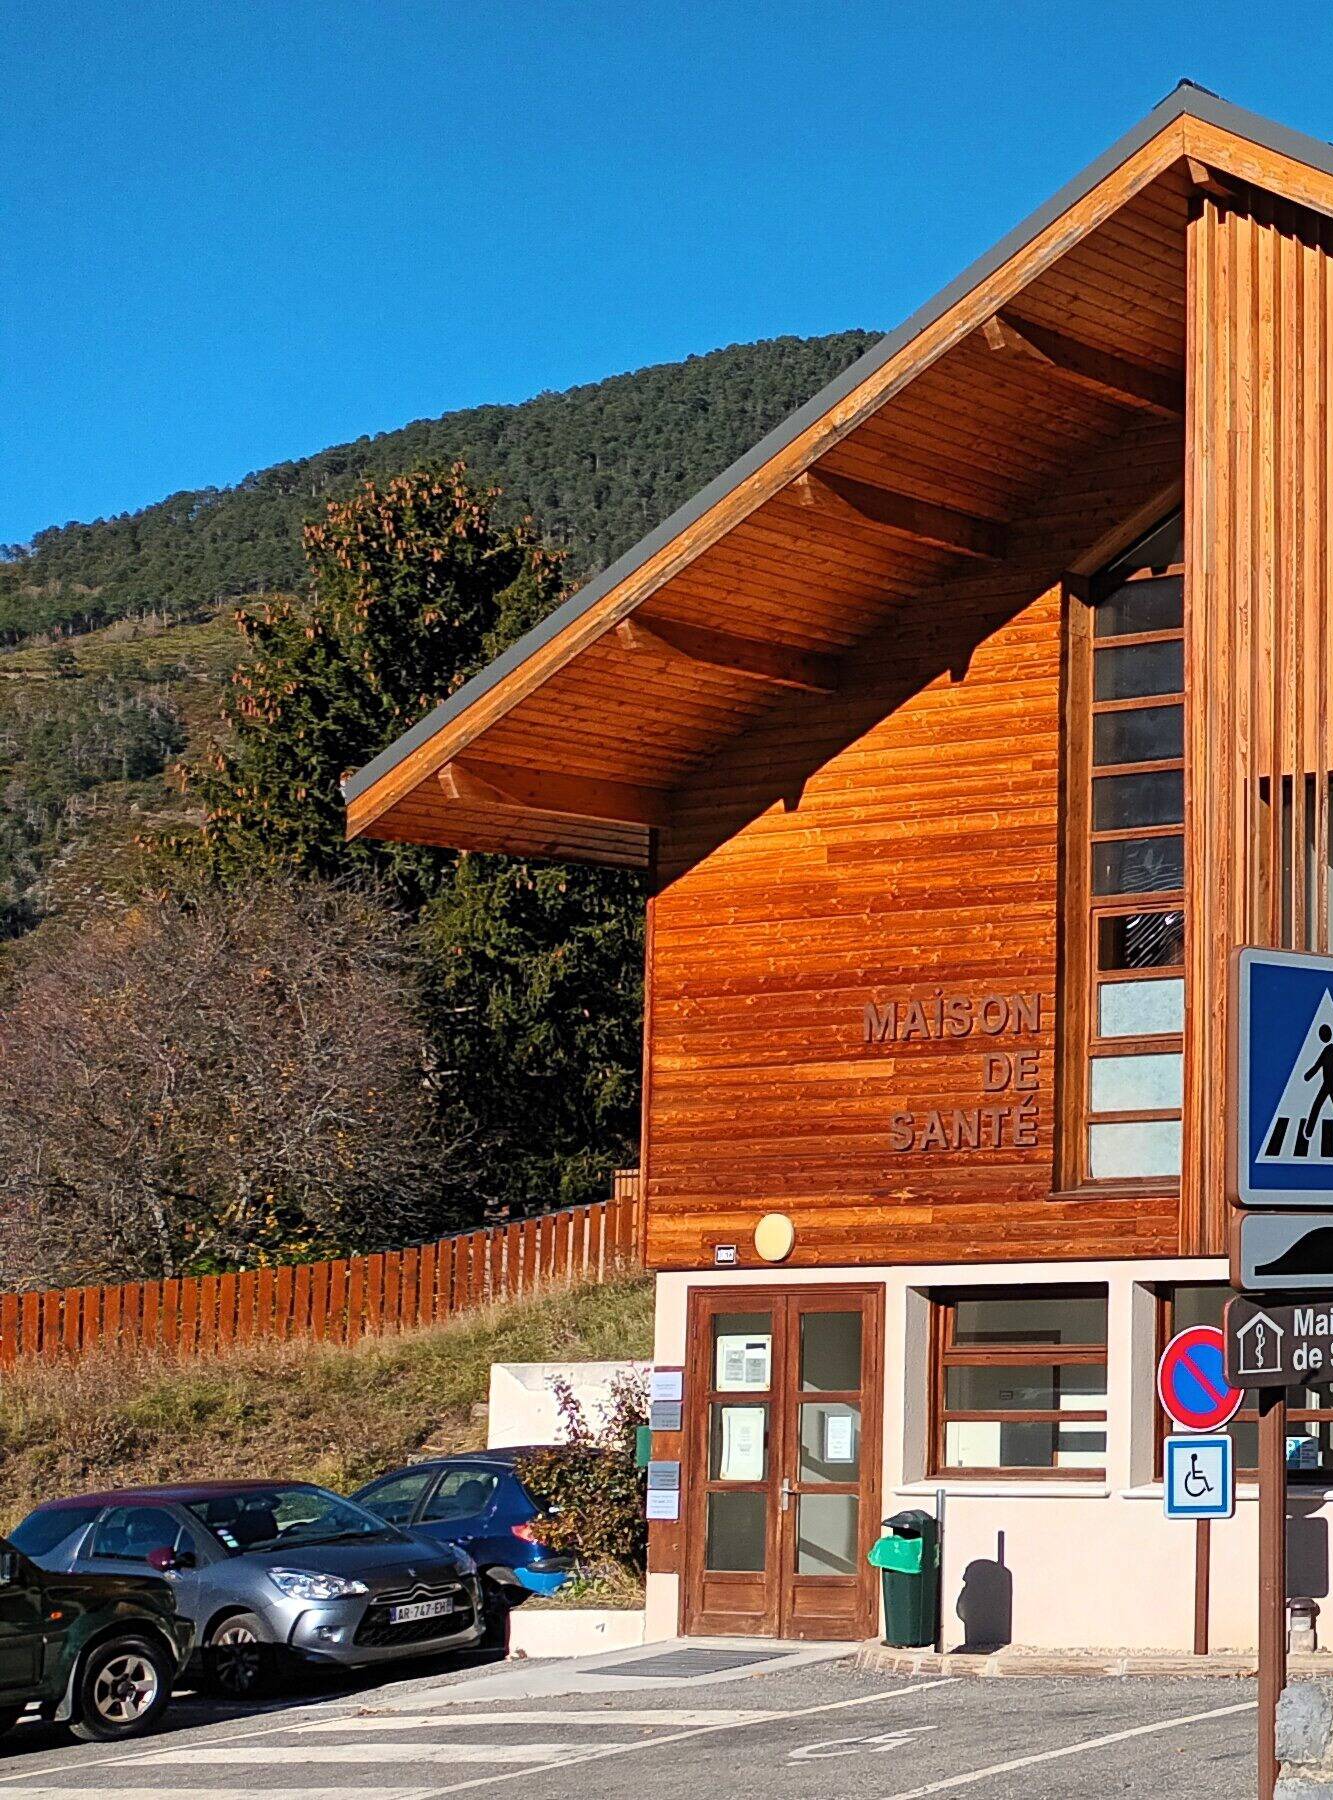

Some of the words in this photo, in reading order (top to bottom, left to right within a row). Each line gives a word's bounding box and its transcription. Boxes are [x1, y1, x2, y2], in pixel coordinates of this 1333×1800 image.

[982, 1049, 1040, 1092] DE
[889, 1094, 1040, 1152] SANTÉ
[1292, 1342, 1323, 1371] de
